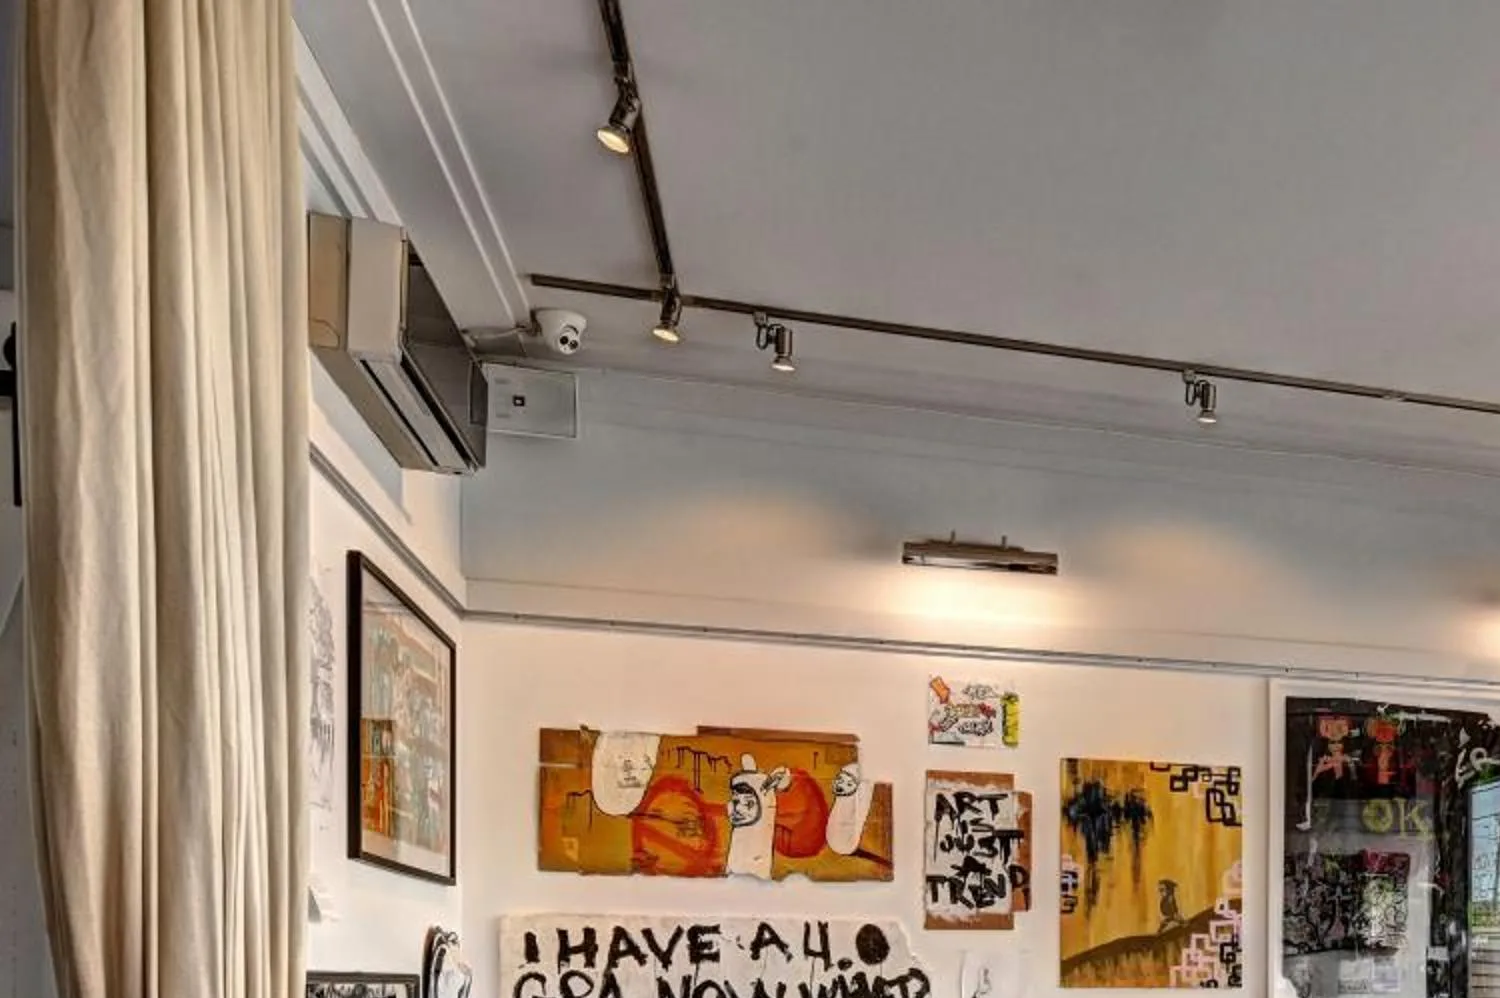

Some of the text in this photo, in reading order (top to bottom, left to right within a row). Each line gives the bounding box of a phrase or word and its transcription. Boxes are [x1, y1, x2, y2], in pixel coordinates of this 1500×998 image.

[934, 791, 1009, 826] ART
[958, 817, 996, 836] IS
[939, 829, 1024, 863] JUST
[925, 864, 1031, 909] TREND
[523, 932, 541, 962] I
[556, 925, 721, 970] HAVE
[750, 921, 793, 963] A
